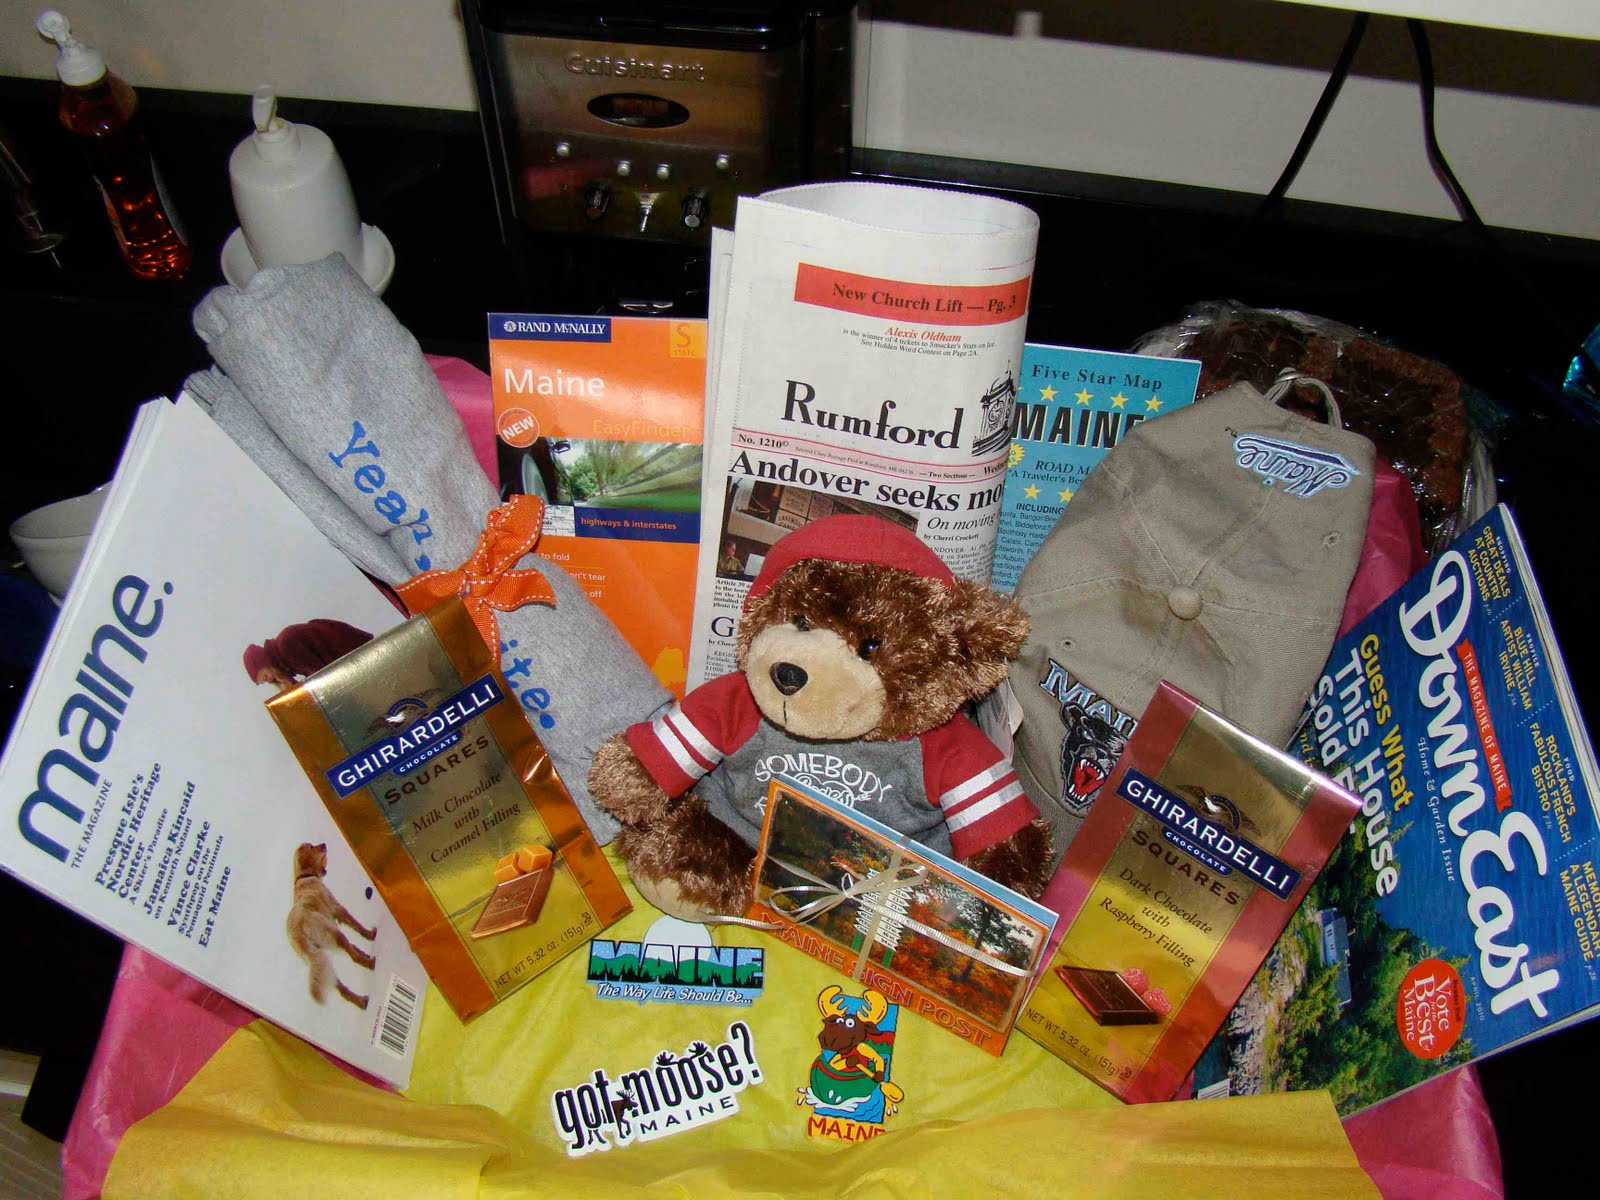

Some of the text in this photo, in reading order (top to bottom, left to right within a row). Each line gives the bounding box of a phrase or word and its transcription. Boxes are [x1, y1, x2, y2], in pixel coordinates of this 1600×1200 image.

[564, 52, 705, 82] Cuisinart
[518, 321, 551, 332] RAND
[832, 283, 867, 301] New
[872, 290, 932, 312] Church
[935, 298, 963, 313] Lift
[861, 332, 884, 341] winner
[899, 338, 921, 346] tickets
[874, 341, 898, 350] Hidden
[899, 345, 917, 353] Word
[917, 347, 942, 355] Contest
[952, 350, 967, 358] Page
[885, 326, 962, 343] Alexis Oldham
[504, 368, 605, 398] Maine
[1032, 364, 1163, 391] Five Star Map
[502, 415, 535, 440] NEW
[593, 419, 688, 438] EasyFinder
[738, 433, 755, 444] No.
[781, 379, 964, 449] Rumford
[729, 450, 870, 496] Andover
[876, 481, 961, 511] seeks
[1021, 470, 1067, 483] Traveler's
[1035, 460, 1074, 474] ROAD
[1233, 433, 1358, 498] Maine
[581, 517, 677, 530] highways & interstates
[923, 533, 931, 541] by
[955, 533, 979, 541] Crockett
[927, 512, 997, 530] On moving
[552, 552, 570, 561] fold
[588, 573, 606, 581] tear
[1468, 548, 1491, 602] AUCTIONS
[1475, 536, 1502, 600] AT COUNTRY
[1482, 525, 1511, 598] GREAT DEALS
[589, 590, 603, 598] off
[1499, 651, 1516, 691] IRVINE
[1500, 619, 1533, 711] ARTIST WILLIAM
[1514, 626, 1537, 687] BLUE HILL
[338, 683, 496, 787] GHIRARDELLI
[1310, 674, 1348, 768] Sold
[1360, 633, 1414, 812] Guess What
[1463, 651, 1507, 793] THE MAGAZINE OF MAINE
[384, 735, 490, 806] SQUARES
[399, 734, 458, 774] CHOCOLATE
[754, 752, 893, 803] SOMEBODY
[1334, 648, 1398, 897] This House
[1529, 722, 1572, 844] FABULOUS FRENCH
[1545, 734, 1576, 817] ROCKLAND'S
[411, 773, 502, 835] Milk Chocolate
[1417, 736, 1455, 883] Home Garden Issue
[1531, 764, 1551, 812] BISTRO
[71, 778, 113, 869] THE MAGAZINE
[95, 773, 145, 886] Presque Isle's
[106, 762, 162, 893] Nordic Heritage
[143, 780, 196, 915] Jamaica Kincaid
[430, 802, 522, 864] Caramel Filling
[454, 808, 480, 830] with
[1126, 779, 1290, 891] GHIRARDELLI
[118, 841, 146, 899] Center
[129, 807, 169, 906] A Skier's Paradise
[154, 818, 193, 920] on Kenneth Noland
[167, 820, 211, 927] Vince Clarke
[1131, 829, 1241, 906] SQUARES
[1165, 831, 1227, 873] CHOCOLATE
[1569, 864, 1580, 875] A
[178, 847, 211, 934] Synthpop on the
[184, 834, 224, 939] Pemaquid Peninsula
[198, 865, 232, 948] Eat Maine
[1118, 867, 1213, 935] Dark Chocolate
[1141, 905, 1171, 928] with
[1560, 869, 1594, 962] MAINE GUIDE
[494, 922, 585, 989] NET WT 5.32 (151g)
[1099, 896, 1195, 968] Raspberry Filling
[587, 939, 764, 988] MAINE
[597, 983, 752, 1004] The Way Life Should Be...
[761, 912, 845, 967] MAINE
[848, 959, 912, 1006] SIGN
[916, 1000, 992, 1047] POST
[1403, 986, 1416, 1041] Maine
[1414, 973, 1435, 1049] Best
[1435, 975, 1452, 1031] Vote
[1470, 976, 1485, 1021] APRIL 2010
[1025, 1008, 1120, 1077] NET WT 5.32 (151g)
[555, 1022, 760, 1149] got moose?
[639, 1095, 734, 1135] MAINE
